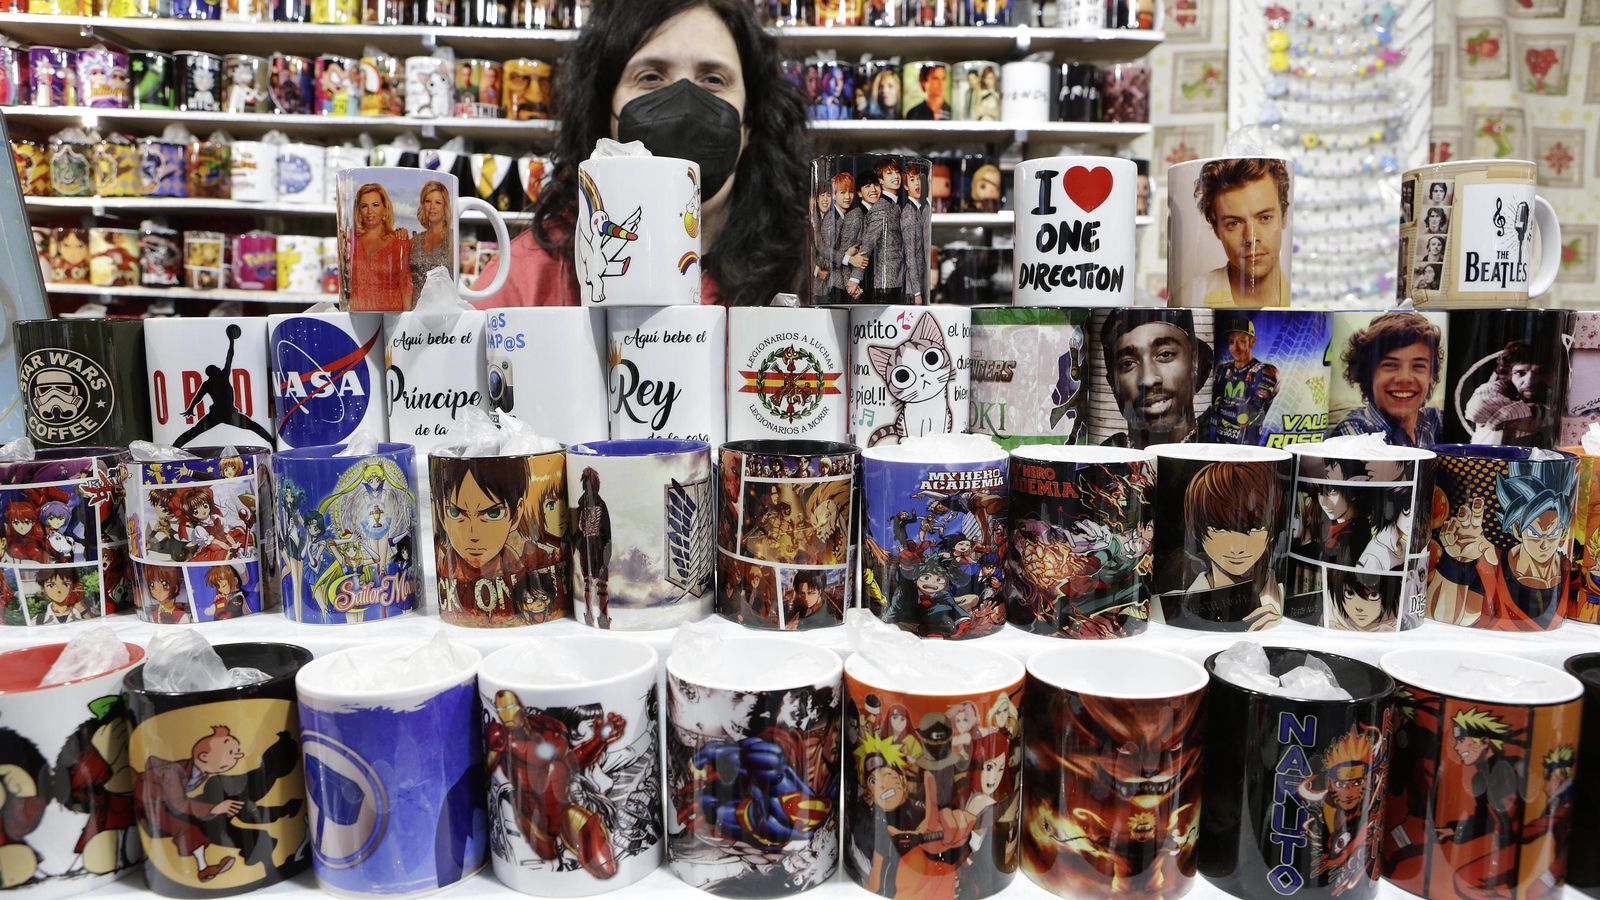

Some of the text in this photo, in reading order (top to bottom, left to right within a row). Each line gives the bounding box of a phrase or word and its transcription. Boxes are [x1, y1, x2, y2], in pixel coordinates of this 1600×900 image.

[1031, 170, 1059, 215] I
[1036, 220, 1101, 255] ONE
[1465, 251, 1527, 288] BEATLES
[1496, 251, 1509, 260] THE
[1019, 262, 1124, 293] DIRECTION
[393, 331, 473, 350] Aquí bebe el
[624, 328, 707, 349] Aquí bebe el
[853, 319, 898, 344] gatito
[948, 323, 959, 337] el
[746, 333, 799, 369] LEGIONARIOS
[809, 337, 834, 370] LUCHAR
[20, 352, 107, 393] STAR WARS
[153, 367, 254, 425] ORD
[385, 364, 483, 420] Príncipe
[609, 359, 682, 431] Rey
[28, 416, 98, 440] COFFEE
[415, 423, 448, 436] de la
[749, 404, 830, 435] LEGIONARIOS A MORIR
[920, 477, 1004, 490] ACADEMIA
[928, 468, 1000, 481] MY HERO
[334, 579, 382, 612] Sailor
[1267, 711, 1317, 896] NARUTO
